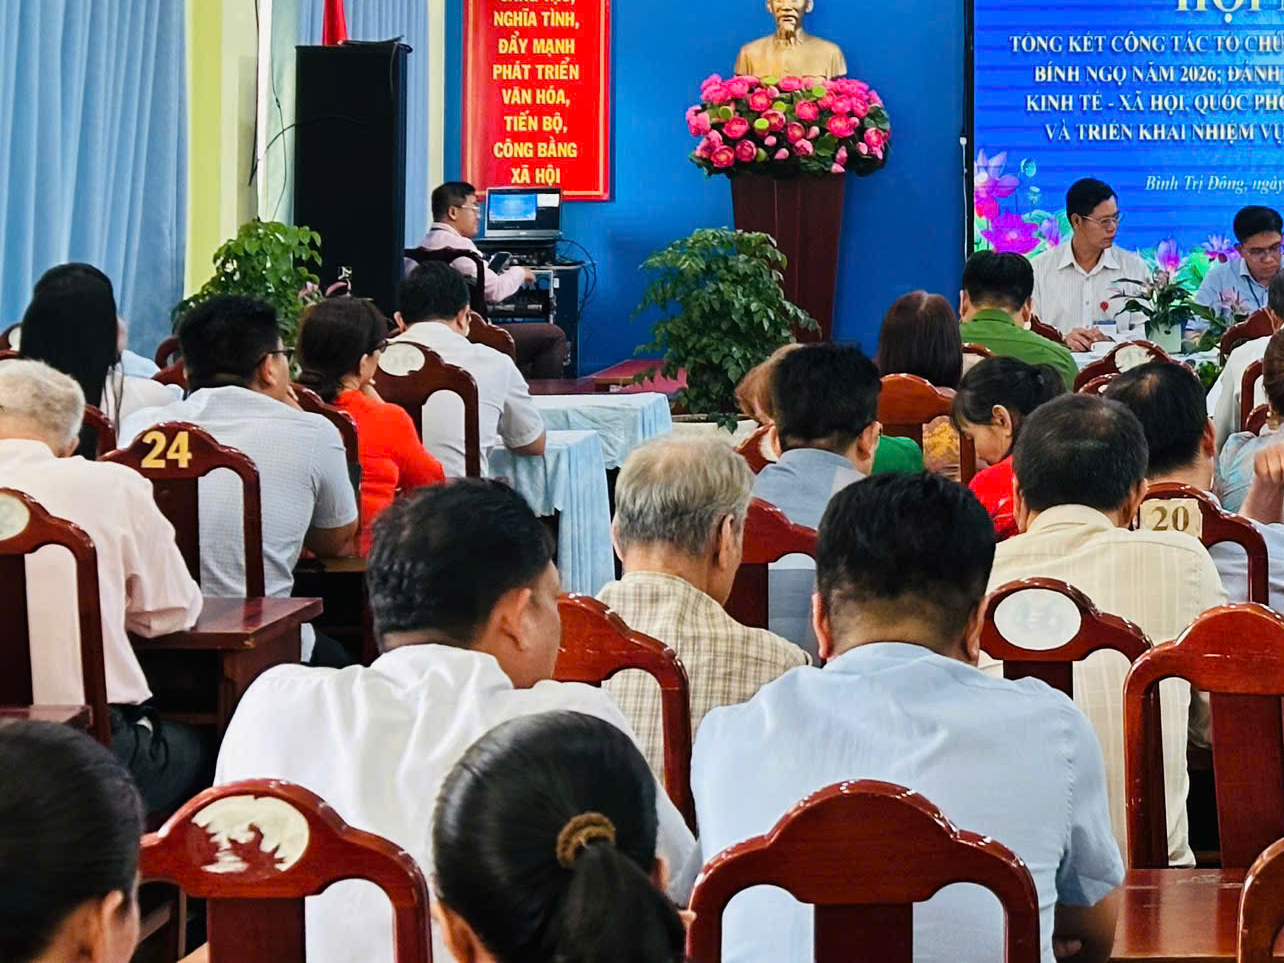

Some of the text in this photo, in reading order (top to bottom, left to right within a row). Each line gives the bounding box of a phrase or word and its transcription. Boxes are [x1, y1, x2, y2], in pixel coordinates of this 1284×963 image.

[494, 8, 579, 29] NGHĨA TÌNH,
[498, 31, 575, 57] ĐẨY MẠNH
[1111, 31, 1165, 53] CÔNG
[1170, 31, 1209, 53] TÁC
[493, 57, 579, 80] PHÁT TRIỂN
[1035, 61, 1080, 82] BÍNH
[1085, 66, 1127, 85] NGỌ
[1132, 61, 1175, 82] NĂM
[1180, 66, 1222, 83] 2026;
[1227, 60, 1280, 82] ĐÁNH
[502, 85, 570, 107] VĂN HÓA,
[1026, 94, 1074, 111] KINH
[1119, 90, 1144, 111] XÃ
[504, 110, 567, 134] TIẾN BỘ,
[1044, 119, 1071, 140] VÀ
[1139, 123, 1186, 140] KHAI
[1192, 119, 1255, 144] NHIỆM
[494, 136, 577, 158] CÔNG BẰNG
[511, 165, 560, 186] XÃ HỘI
[1144, 175, 1178, 190] Bình
[1184, 175, 1203, 194] Trị
[1207, 175, 1248, 194] Đông,
[141, 430, 192, 468] 24
[1152, 506, 1189, 531] 20
